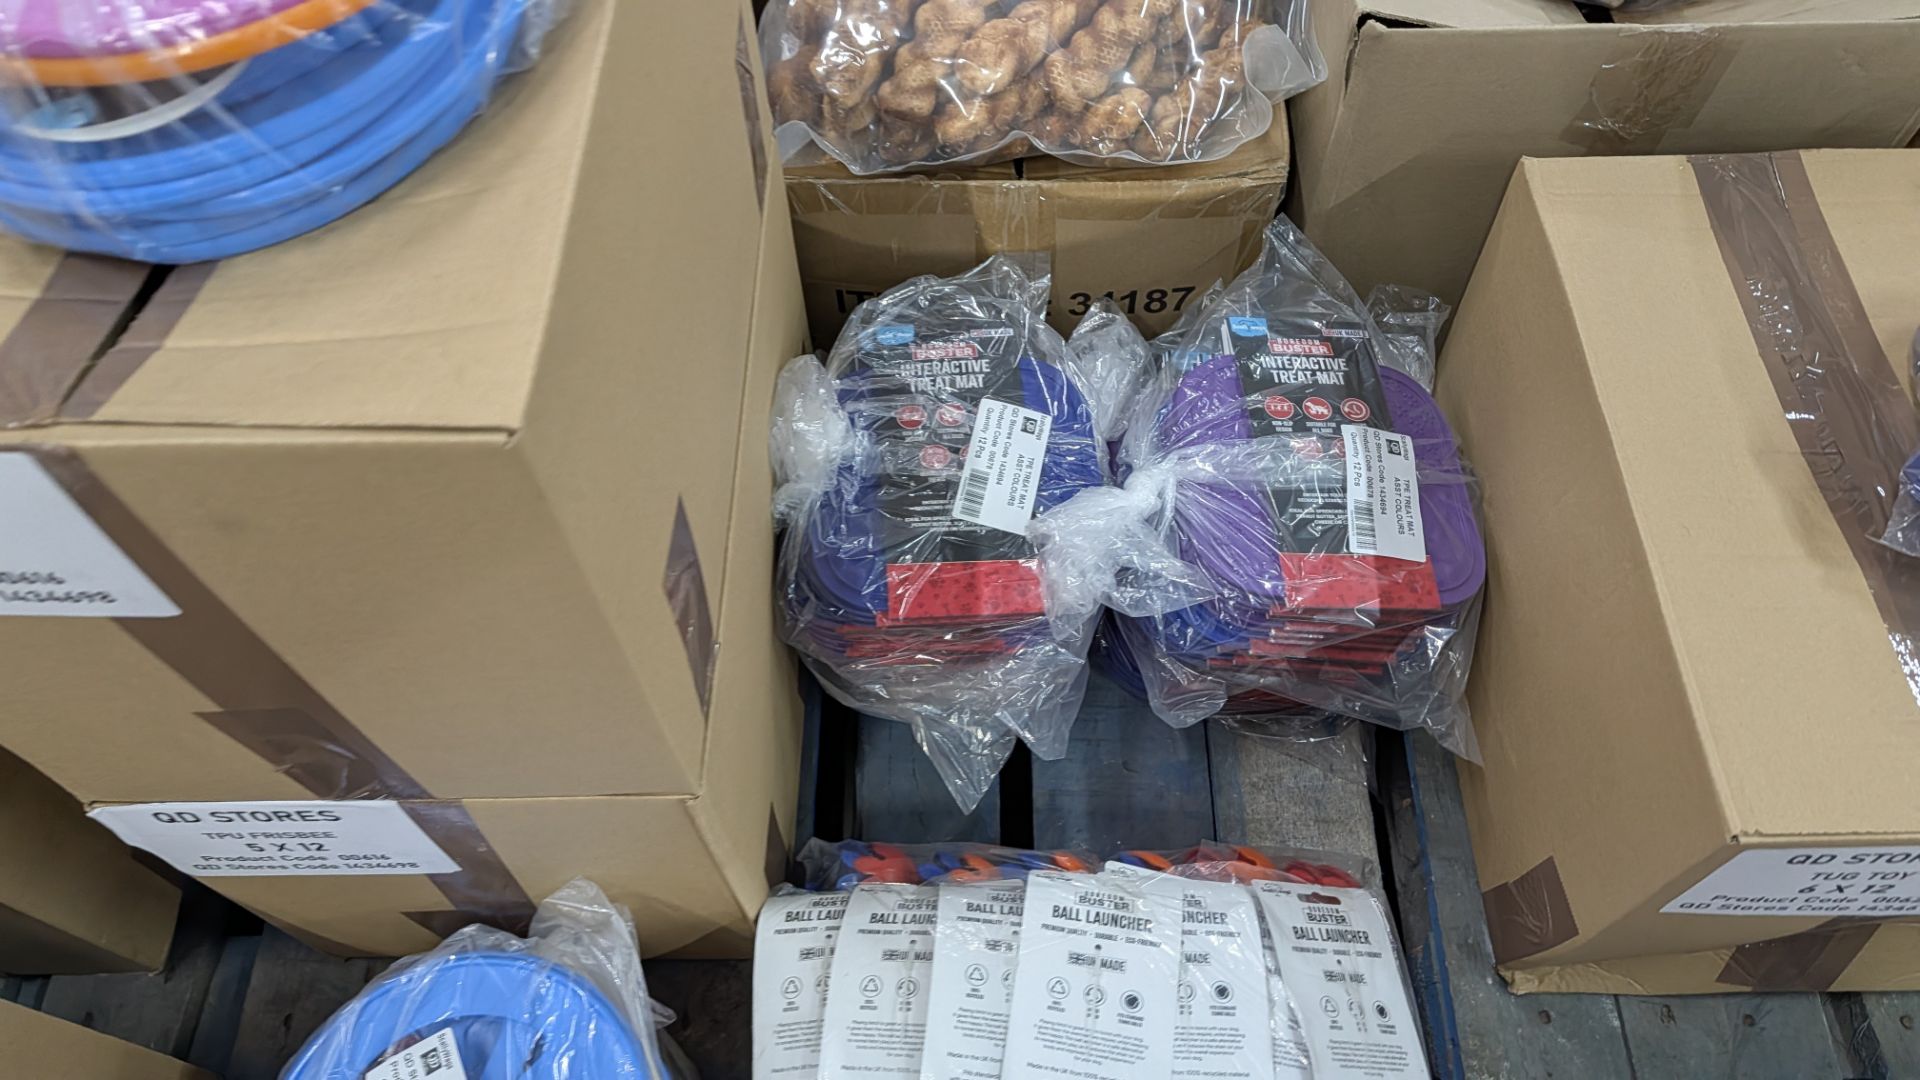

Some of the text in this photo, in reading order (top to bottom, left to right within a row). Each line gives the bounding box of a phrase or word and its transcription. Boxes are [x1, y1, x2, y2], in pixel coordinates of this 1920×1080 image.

[1273, 344, 1329, 354] BUSTER
[900, 359, 990, 377] INTERACTIVE
[1260, 355, 1349, 371] INTERACTIVE
[910, 374, 985, 393] TREAT MAT
[1270, 370, 1344, 385] TREAT MAT
[980, 407, 994, 434] Quantity
[995, 404, 1007, 430] Product
[1006, 419, 1017, 440] Stores
[990, 430, 1001, 447] Code
[1350, 431, 1359, 459] Quantity
[1362, 428, 1370, 453] Product
[974, 445, 986, 459] Pcs
[1002, 442, 1012, 458] Code
[1353, 462, 1361, 470] 12
[1007, 454, 1025, 506] ASST COLOURS
[1017, 457, 1035, 510] TPE TREAT MAT
[1353, 471, 1362, 487] Pcs
[1375, 442, 1383, 463] Stores
[1379, 486, 1387, 515] 1434694
[1395, 498, 1405, 535] COLOURS
[1403, 480, 1415, 537] TPE TREAT MAT
[153, 810, 343, 824] QD STORES
[202, 831, 338, 840] TPU FRISBEE
[245, 843, 265, 852] 5
[297, 843, 332, 852] 12
[200, 855, 276, 863] Product
[1786, 854, 1838, 865] QD
[1810, 871, 1918, 880] TUG TOY
[1797, 884, 1818, 894] 6
[1861, 884, 1896, 894] 12
[1079, 895, 1130, 911] BUSTER
[1710, 895, 1799, 903] Product
[1716, 903, 1789, 911] Stores
[966, 902, 996, 914] BALL
[784, 911, 813, 922] BALL
[869, 913, 899, 924] BALL
[1052, 904, 1152, 933] BALL LAUNCHER
[1307, 912, 1348, 925] BUSTER
[1292, 926, 1372, 945] BALL LAUNCHER
[1100, 957, 1127, 972] MADE
[1184, 953, 1211, 964] MADE
[403, 1052, 416, 1069] QD
